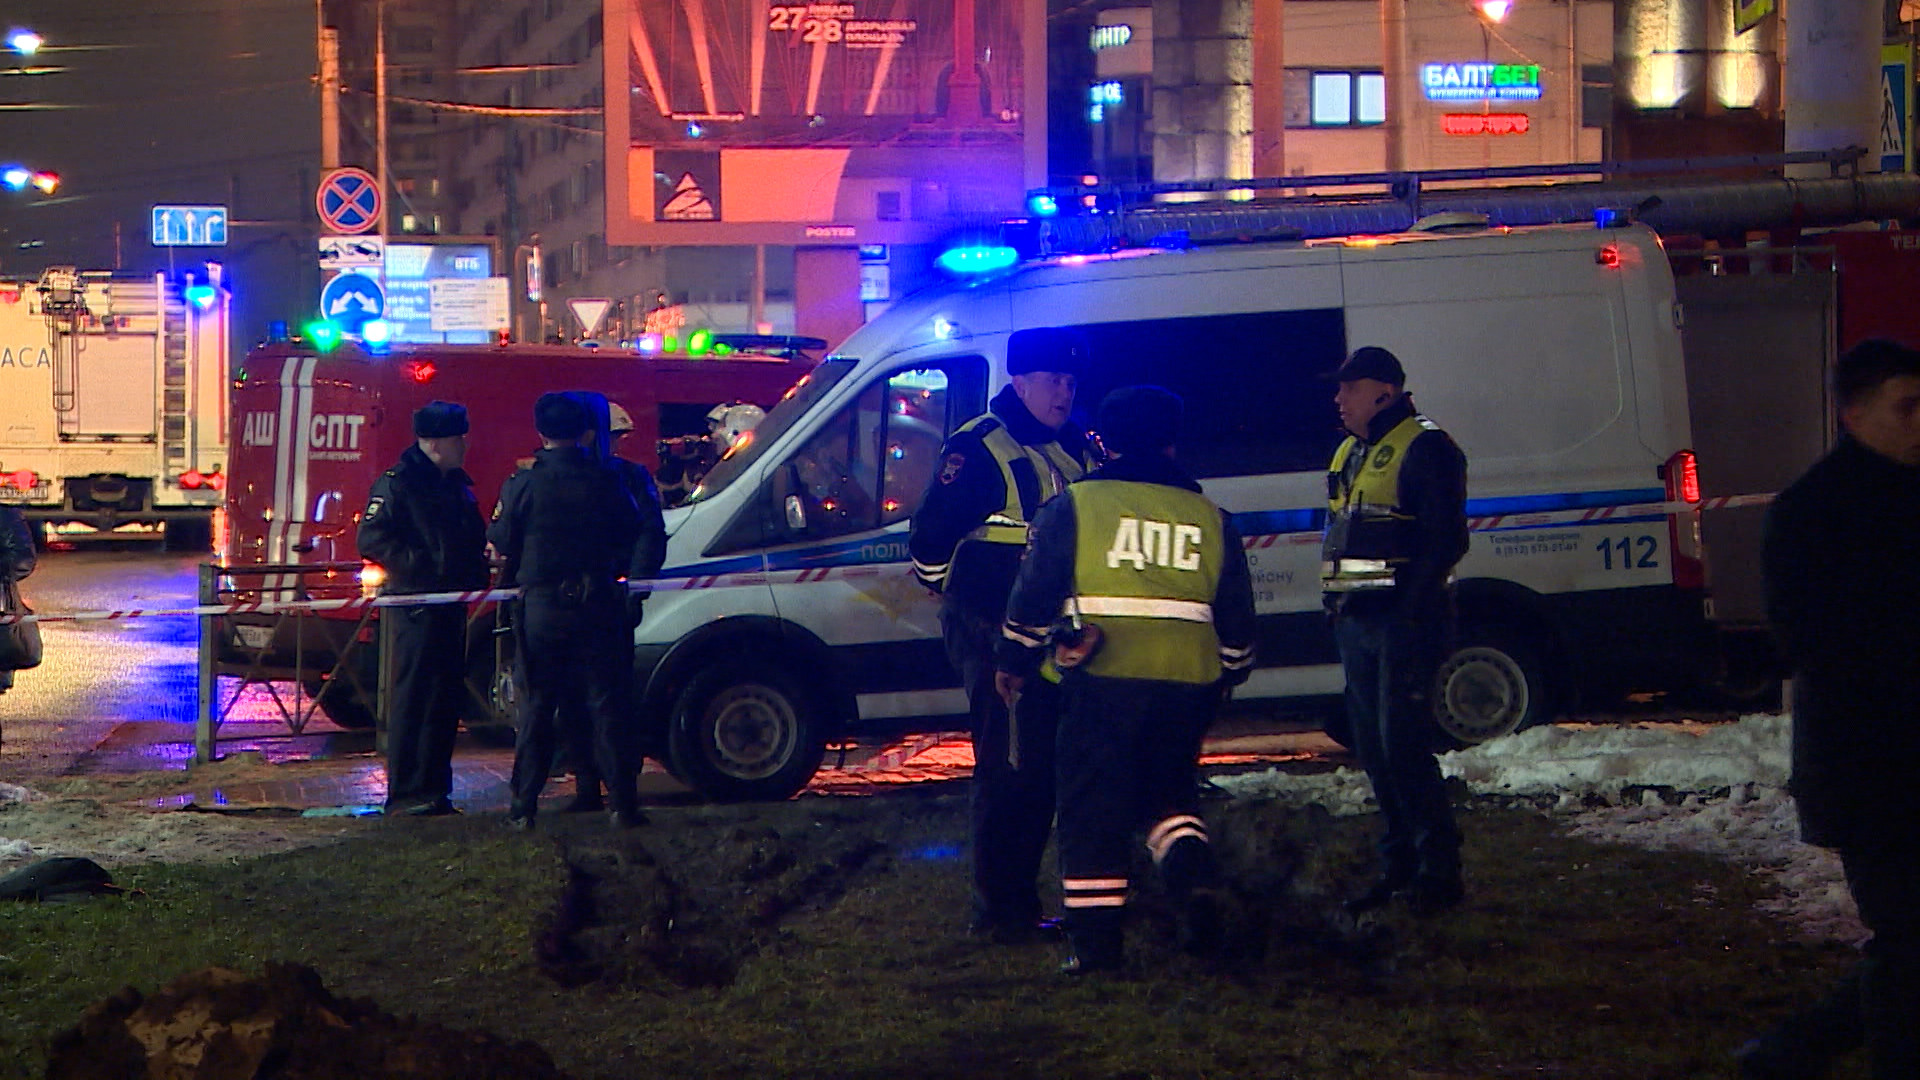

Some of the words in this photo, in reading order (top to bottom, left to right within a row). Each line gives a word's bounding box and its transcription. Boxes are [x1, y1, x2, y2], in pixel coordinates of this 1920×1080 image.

[769, 8, 806, 30] 27
[803, 20, 842, 42] 28
[1425, 64, 1540, 87] БАЛТБЕТ
[806, 226, 856, 237] POSTER
[454, 257, 480, 270] ВТБ
[242, 411, 275, 446] АШ
[310, 414, 365, 449] СПТ
[1106, 517, 1201, 571] ДПС
[1596, 535, 1658, 570] 112
